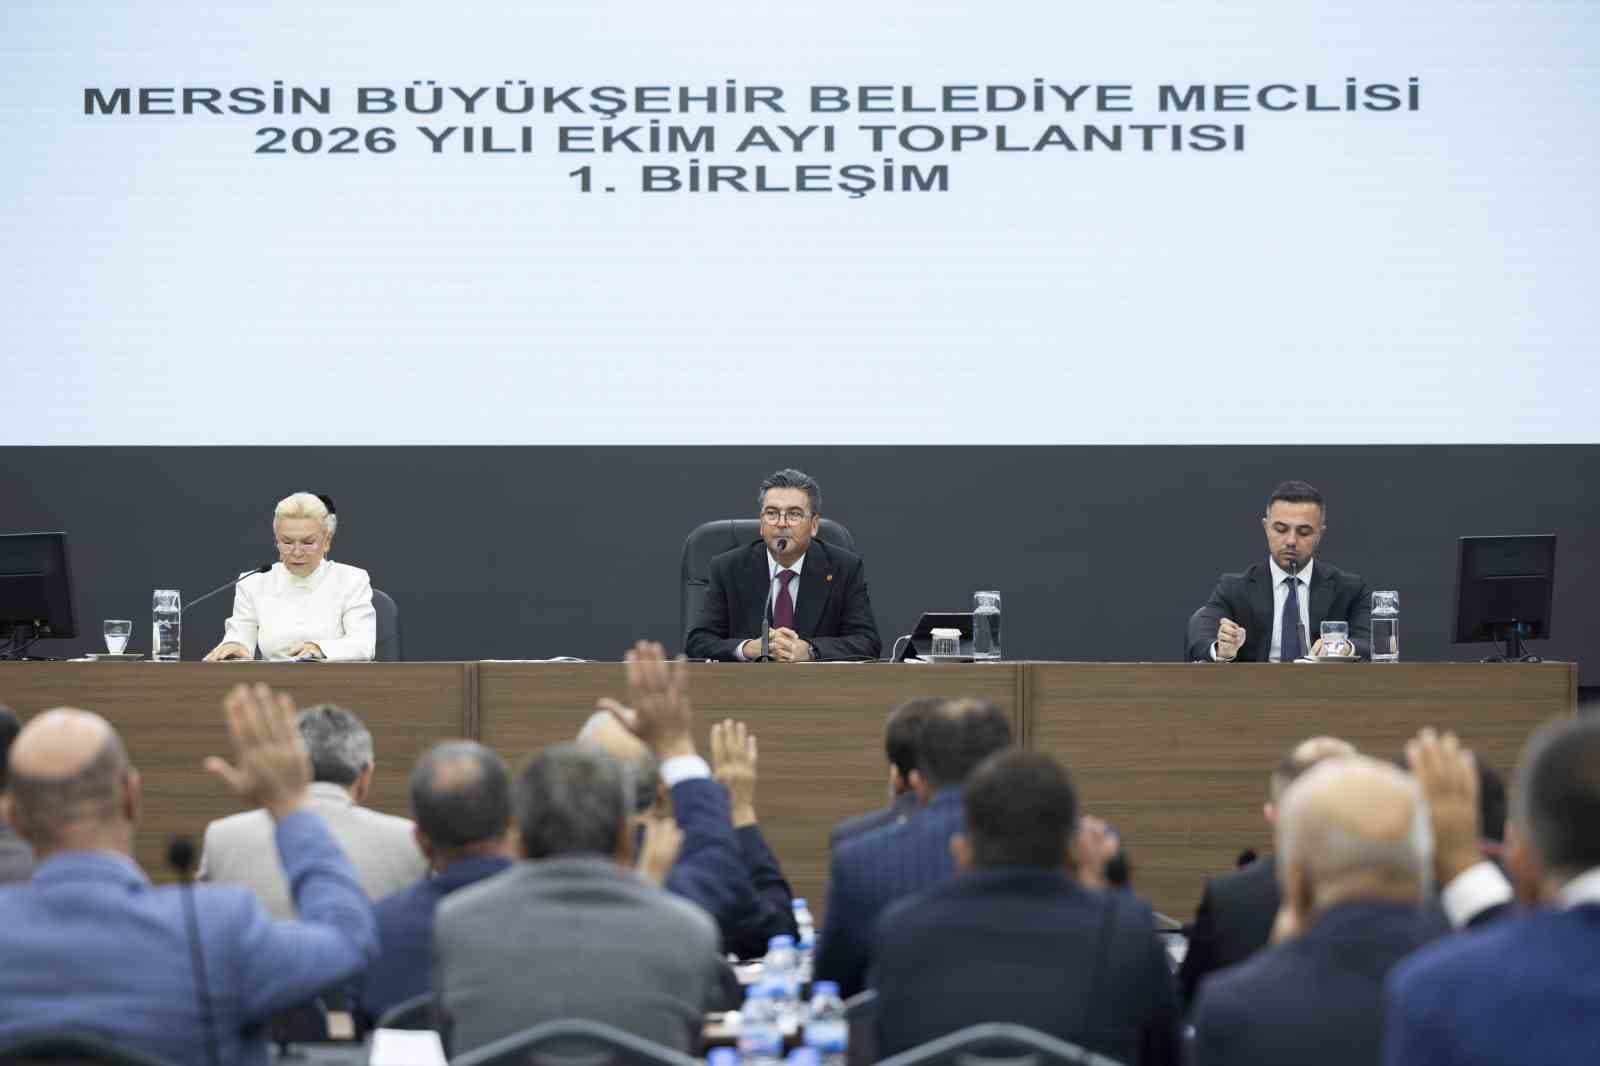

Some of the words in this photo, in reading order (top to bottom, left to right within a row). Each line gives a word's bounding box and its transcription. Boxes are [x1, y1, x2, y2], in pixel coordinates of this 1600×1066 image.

[85, 80, 329, 114] MERSİN
[358, 80, 786, 120] BÜYÜKŞEHİR
[811, 78, 1133, 112] BELEDİYE
[1159, 77, 1419, 111] MECLİSİ
[256, 127, 396, 153] 2026
[417, 126, 532, 152] YILI
[559, 119, 714, 152] EKİM
[736, 126, 834, 152] AYI
[859, 125, 1245, 152] TOPLANTISI
[570, 165, 616, 192] 1.
[643, 158, 949, 198] BİRLEŞİM
